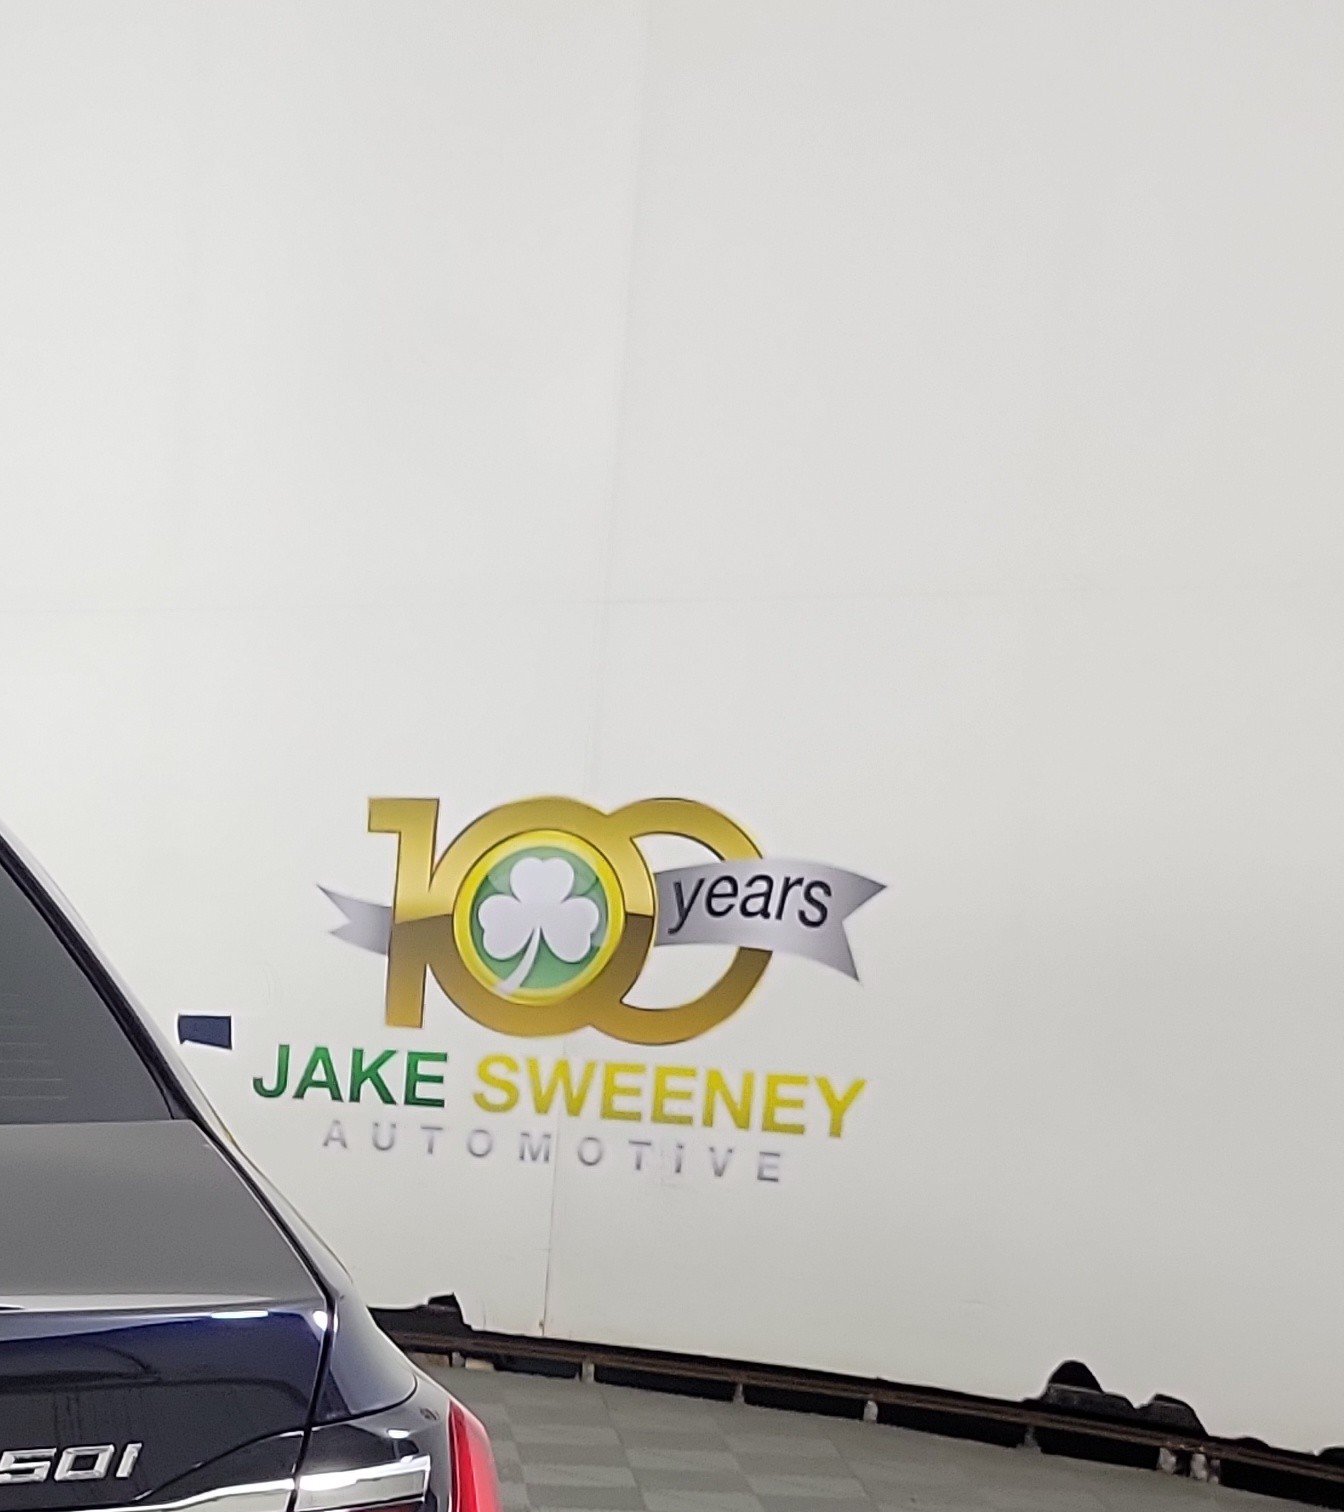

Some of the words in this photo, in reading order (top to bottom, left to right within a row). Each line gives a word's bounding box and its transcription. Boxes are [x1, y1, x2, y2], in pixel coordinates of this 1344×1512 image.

[367, 796, 773, 1046] 100
[667, 871, 834, 937] years
[252, 1043, 449, 1109] JAKE
[472, 1053, 867, 1140] SWEENEY
[322, 1119, 782, 1184] AUTOMOTIVE
